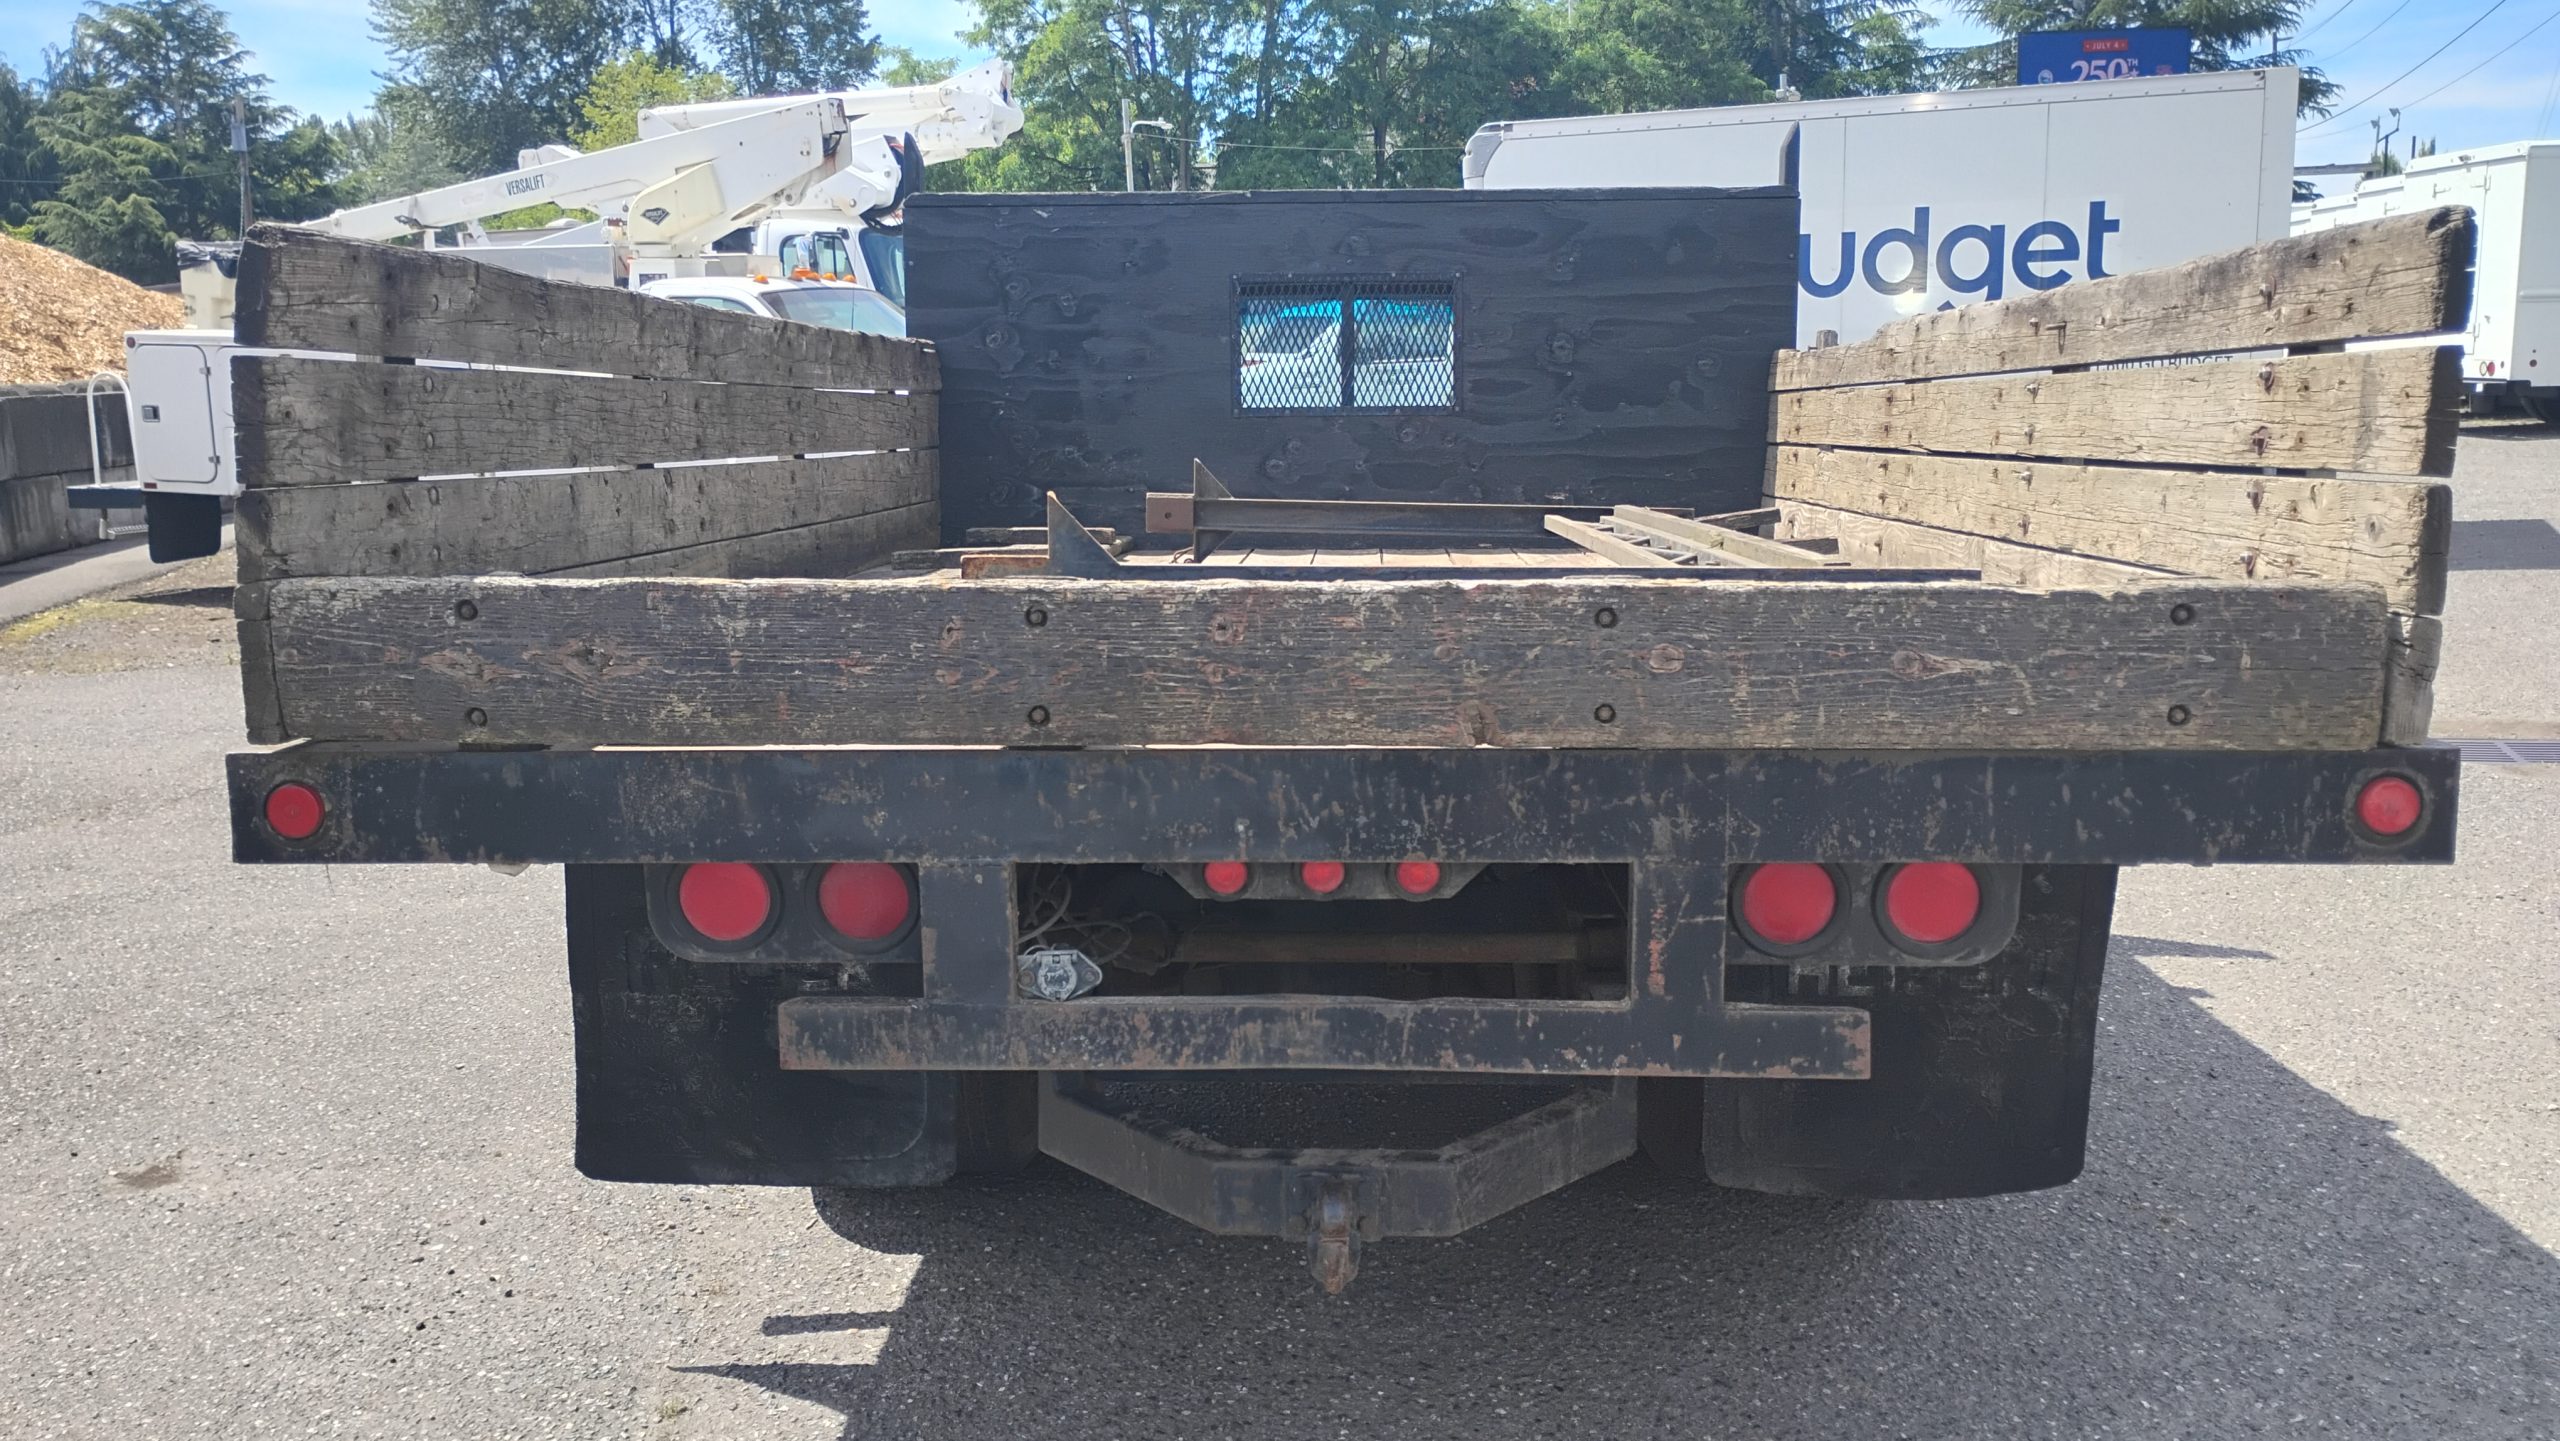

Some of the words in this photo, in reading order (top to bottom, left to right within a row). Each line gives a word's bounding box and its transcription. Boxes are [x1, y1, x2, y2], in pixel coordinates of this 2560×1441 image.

[2091, 41, 2111, 50] JULY
[2113, 41, 2119, 49] 4
[506, 174, 545, 196] VERSALIFT
[1797, 200, 2120, 312] udget
